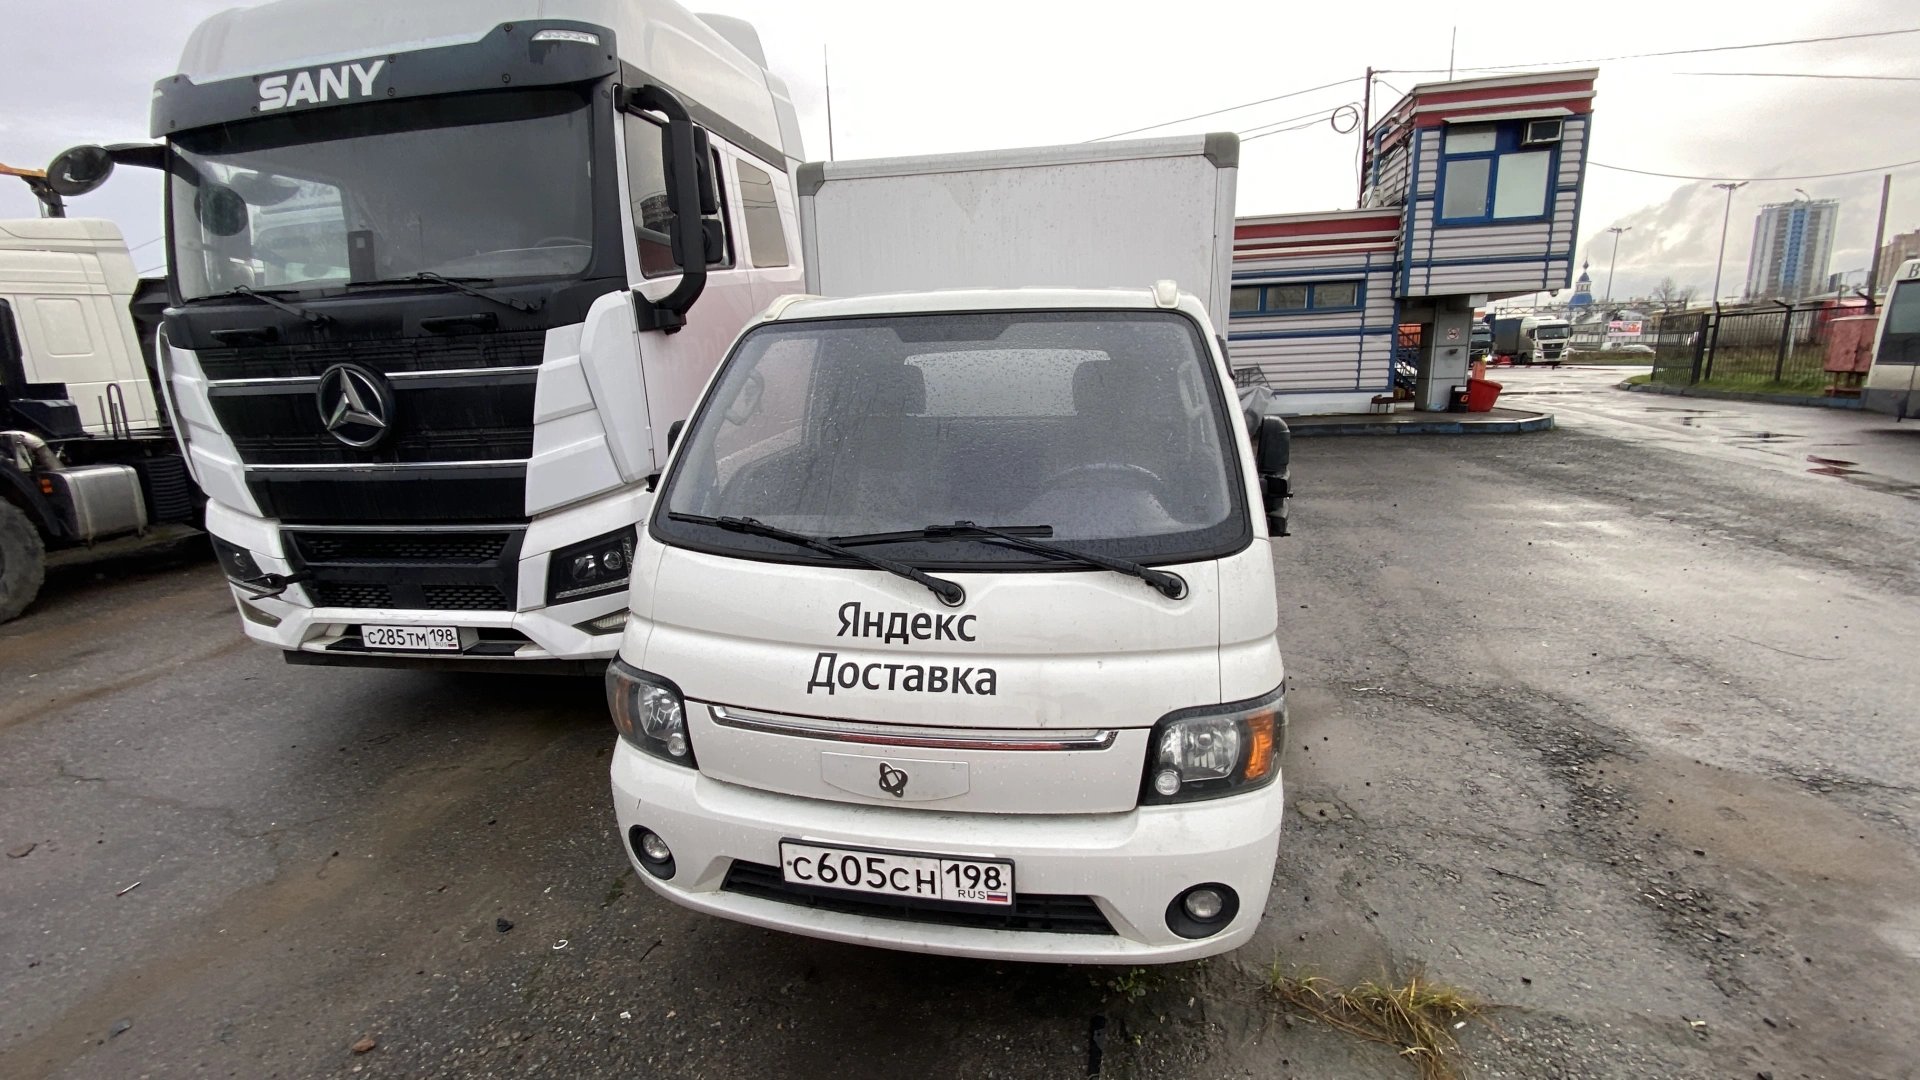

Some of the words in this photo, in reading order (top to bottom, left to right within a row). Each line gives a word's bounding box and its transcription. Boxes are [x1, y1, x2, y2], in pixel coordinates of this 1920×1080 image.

[260, 60, 385, 111] SANY
[368, 628, 428, 646] С285ТМ
[429, 628, 454, 642] 198
[836, 602, 977, 644] Яндекс
[807, 652, 998, 695] Доставка
[793, 853, 937, 894] С605СН
[945, 863, 1002, 890] 198
[957, 889, 986, 900] RUS
